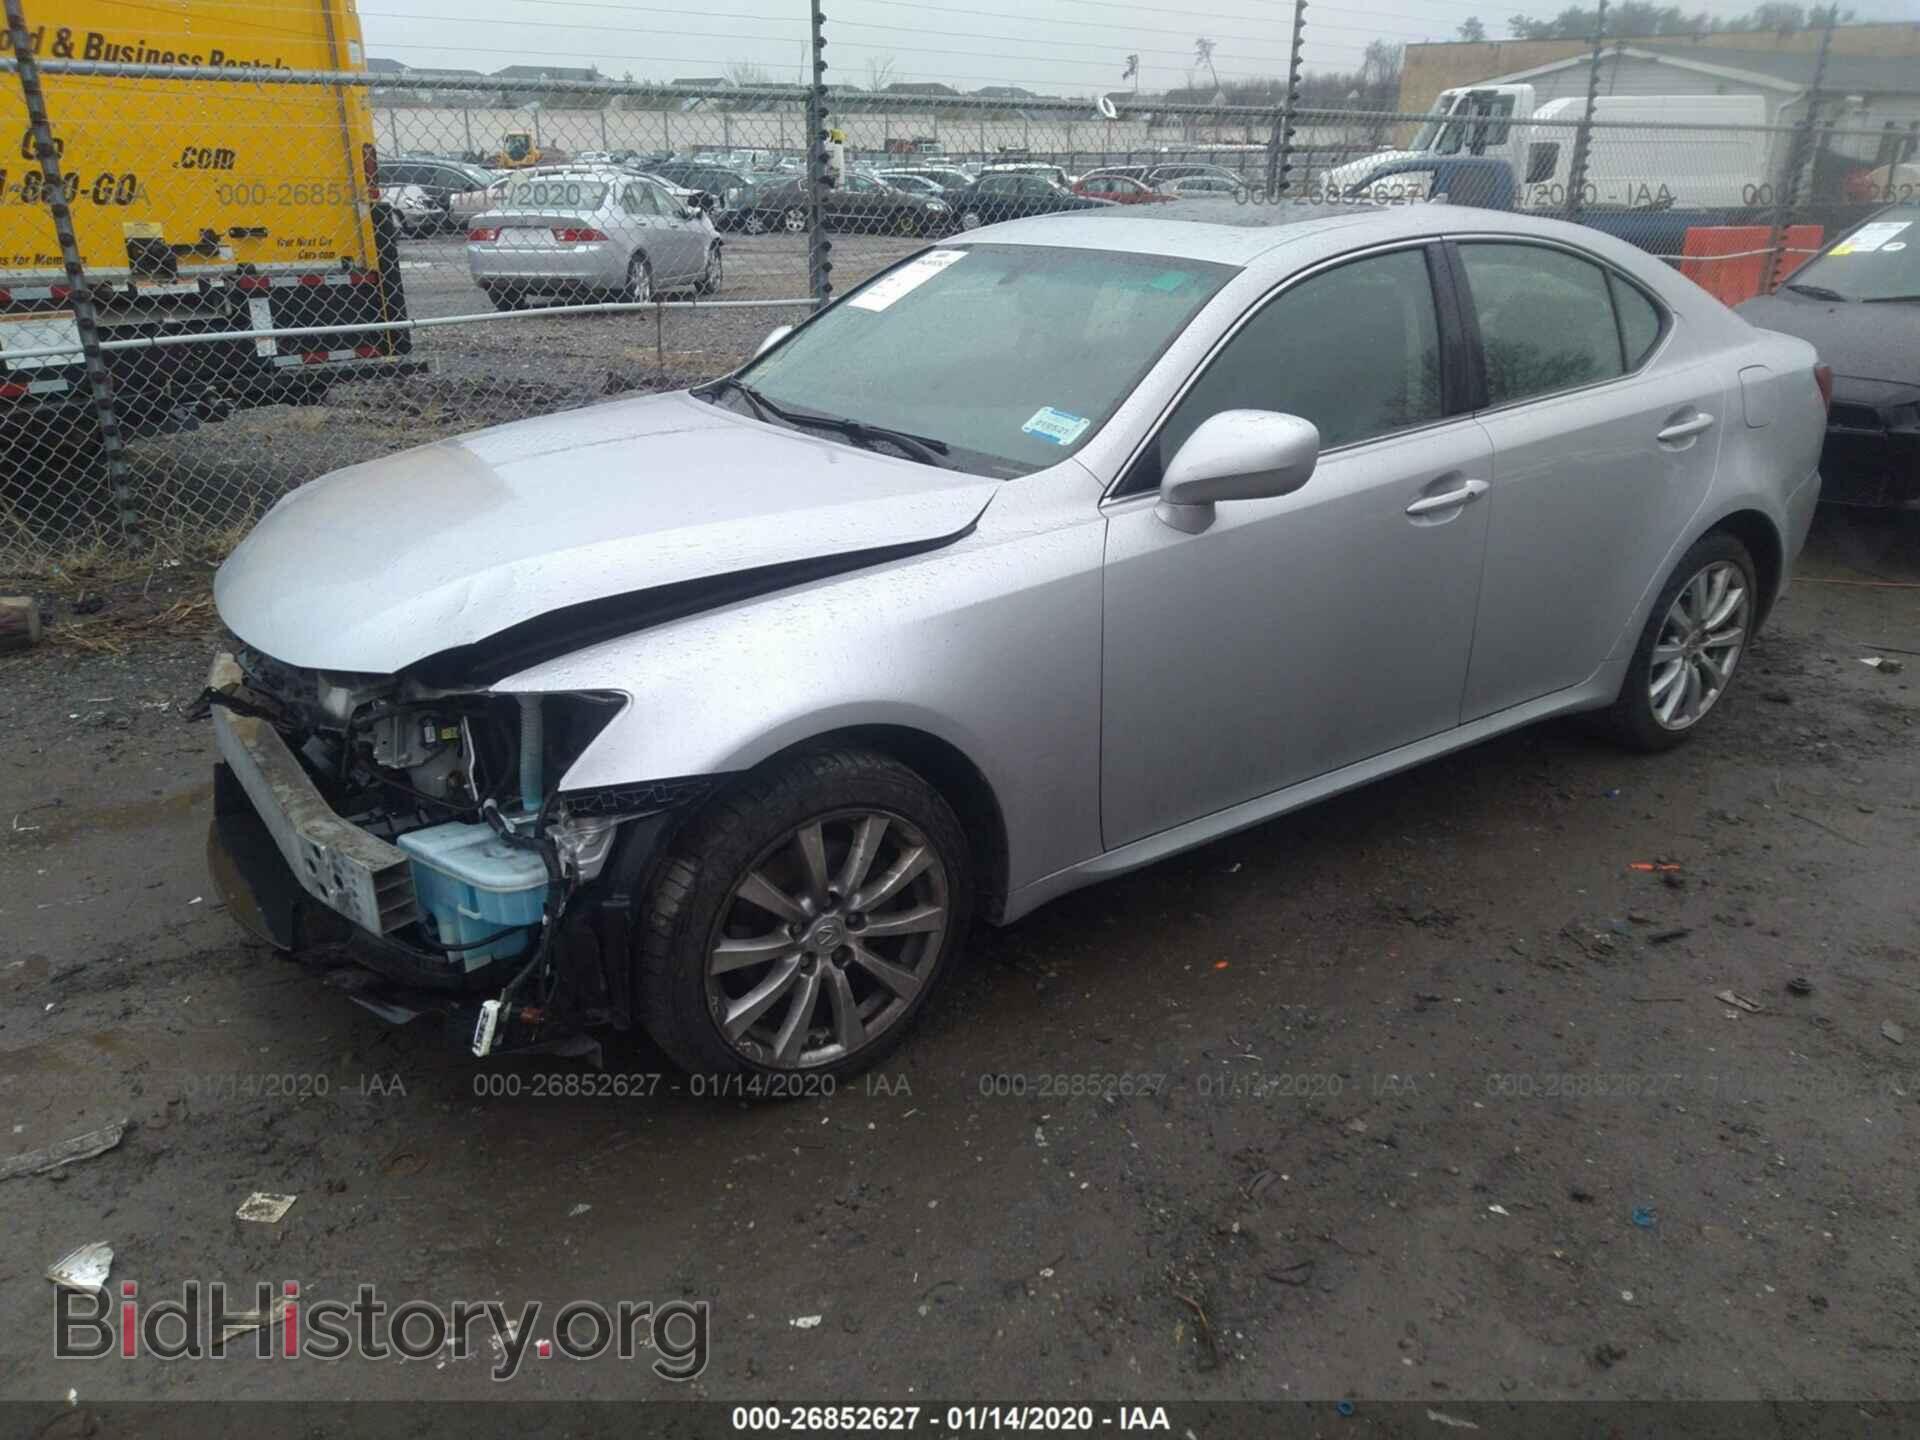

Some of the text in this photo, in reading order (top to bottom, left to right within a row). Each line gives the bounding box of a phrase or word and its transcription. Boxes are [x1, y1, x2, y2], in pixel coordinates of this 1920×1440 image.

[51, 27, 75, 59] &
[84, 32, 204, 66] Business
[173, 146, 236, 170] .com
